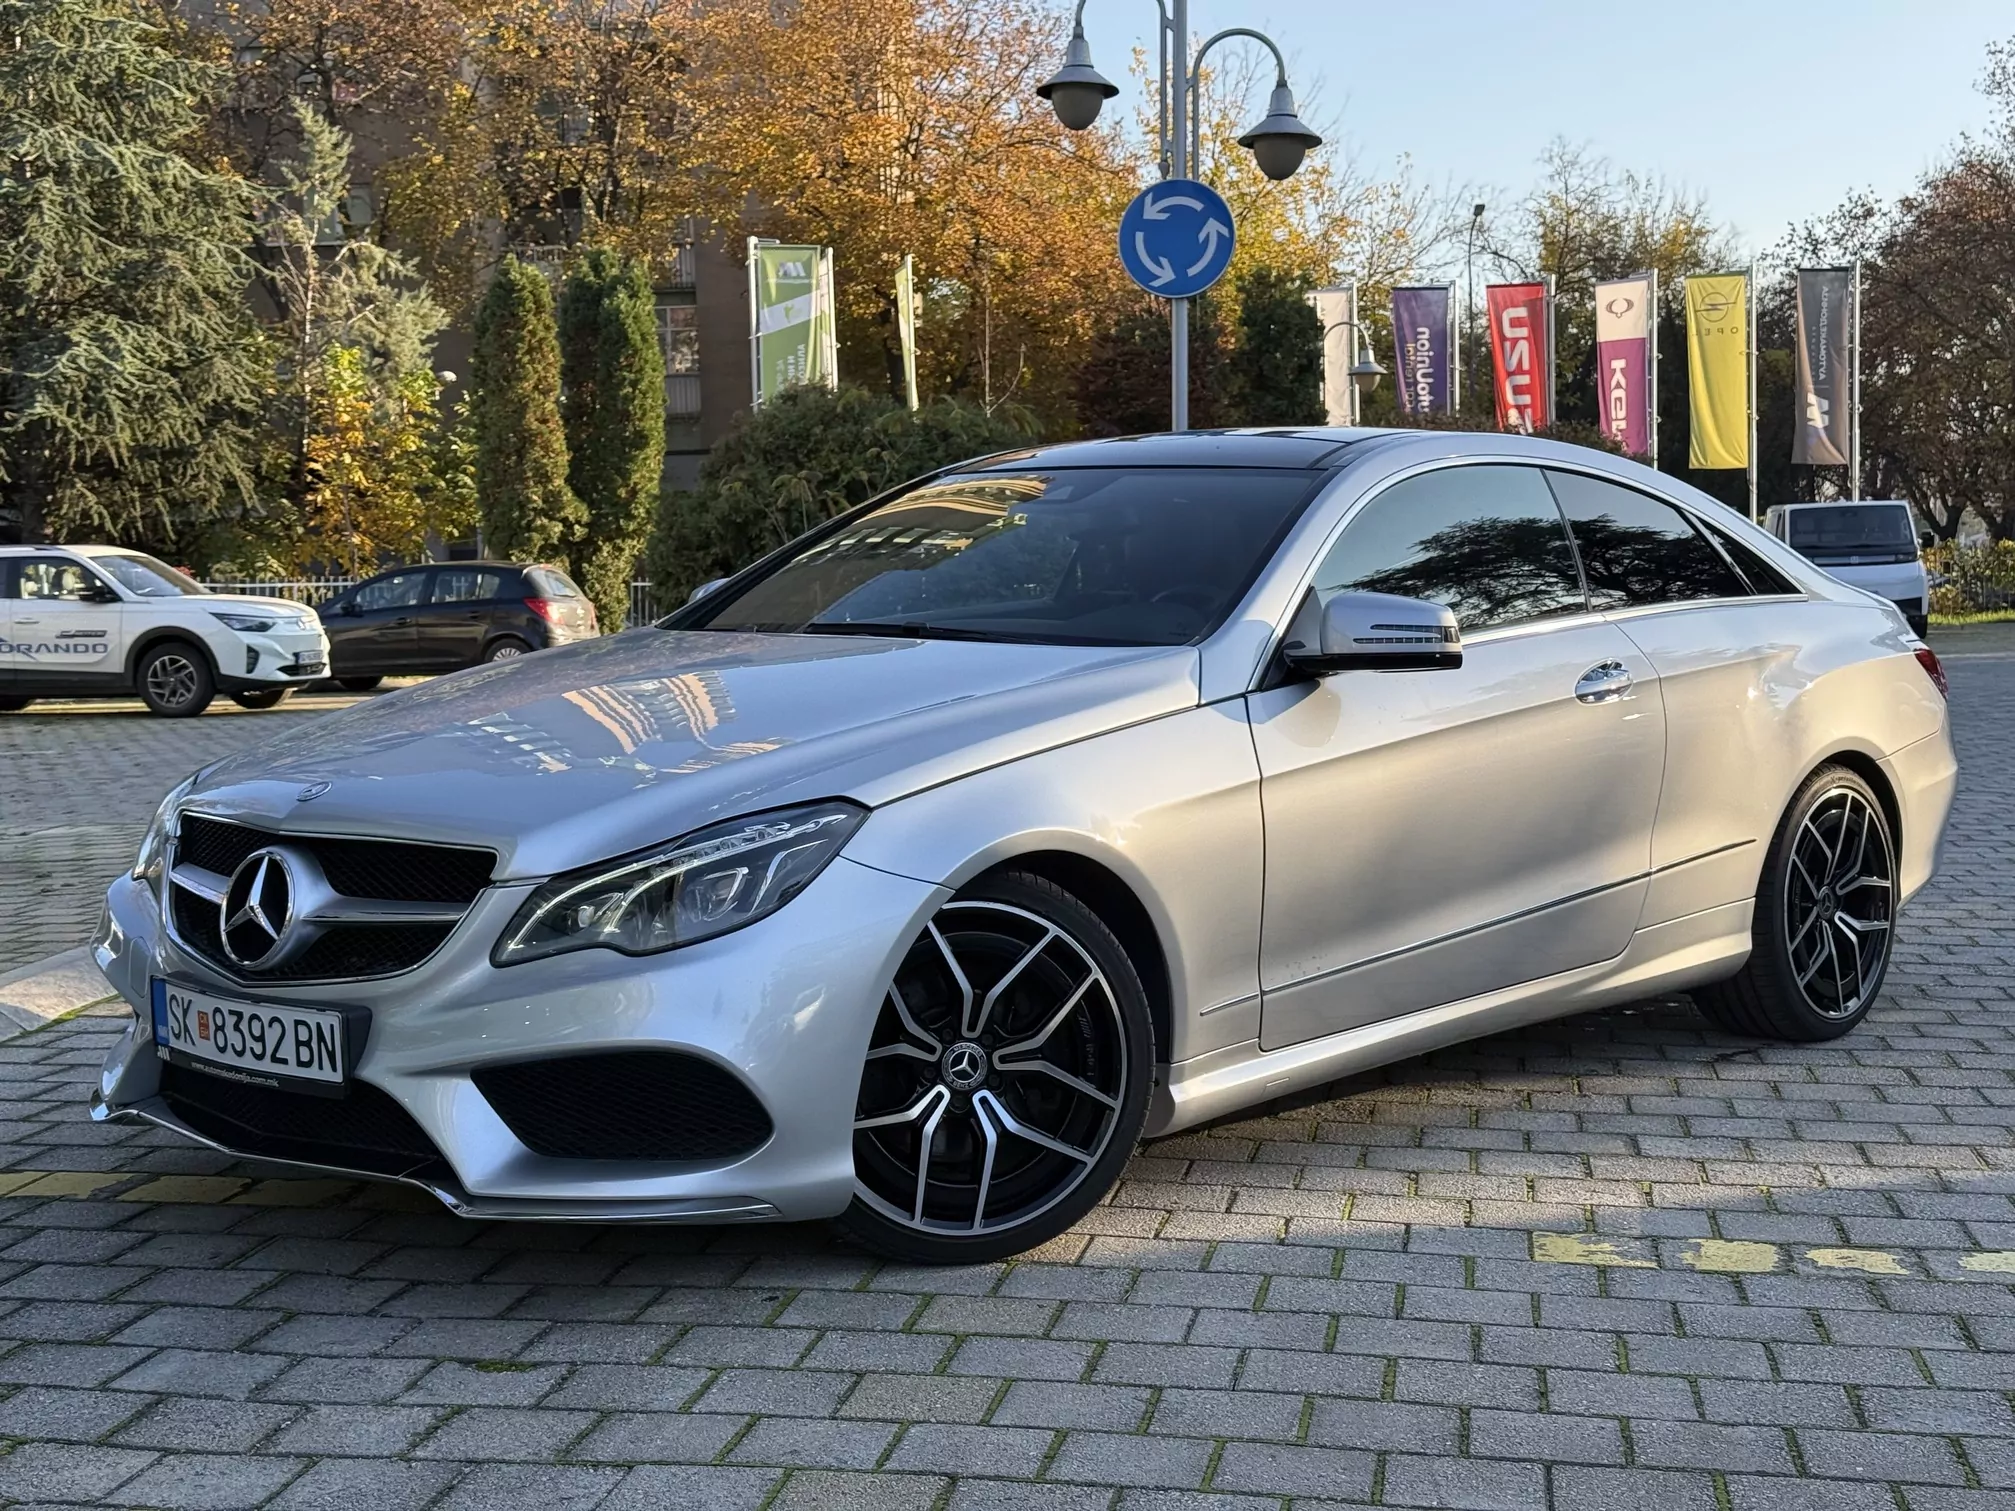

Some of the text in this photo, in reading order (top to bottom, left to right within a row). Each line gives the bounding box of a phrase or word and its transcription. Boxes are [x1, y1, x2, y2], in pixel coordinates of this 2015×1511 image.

[0, 643, 108, 660] ORANDO
[169, 993, 338, 1073] SK 8392 BN
